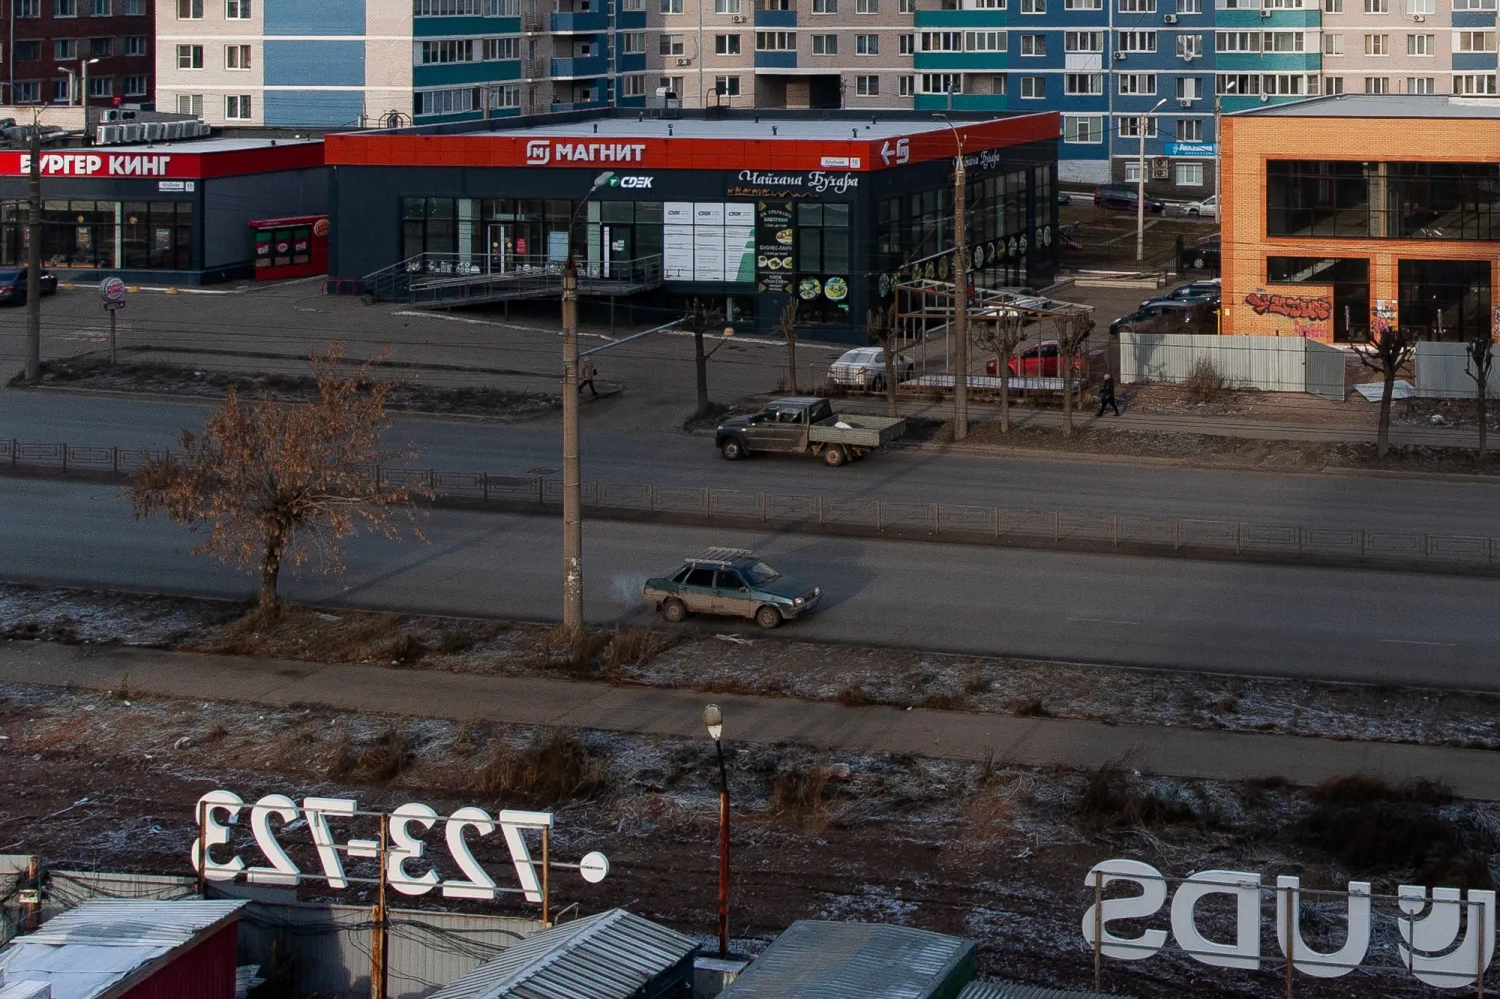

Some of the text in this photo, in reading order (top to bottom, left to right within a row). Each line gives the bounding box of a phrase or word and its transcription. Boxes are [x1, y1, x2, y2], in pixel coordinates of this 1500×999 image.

[555, 144, 646, 162] МАГНИТ
[108, 156, 171, 176] КИНГ
[620, 176, 654, 189] CDEK
[739, 170, 859, 193] Чайхана Бухара
